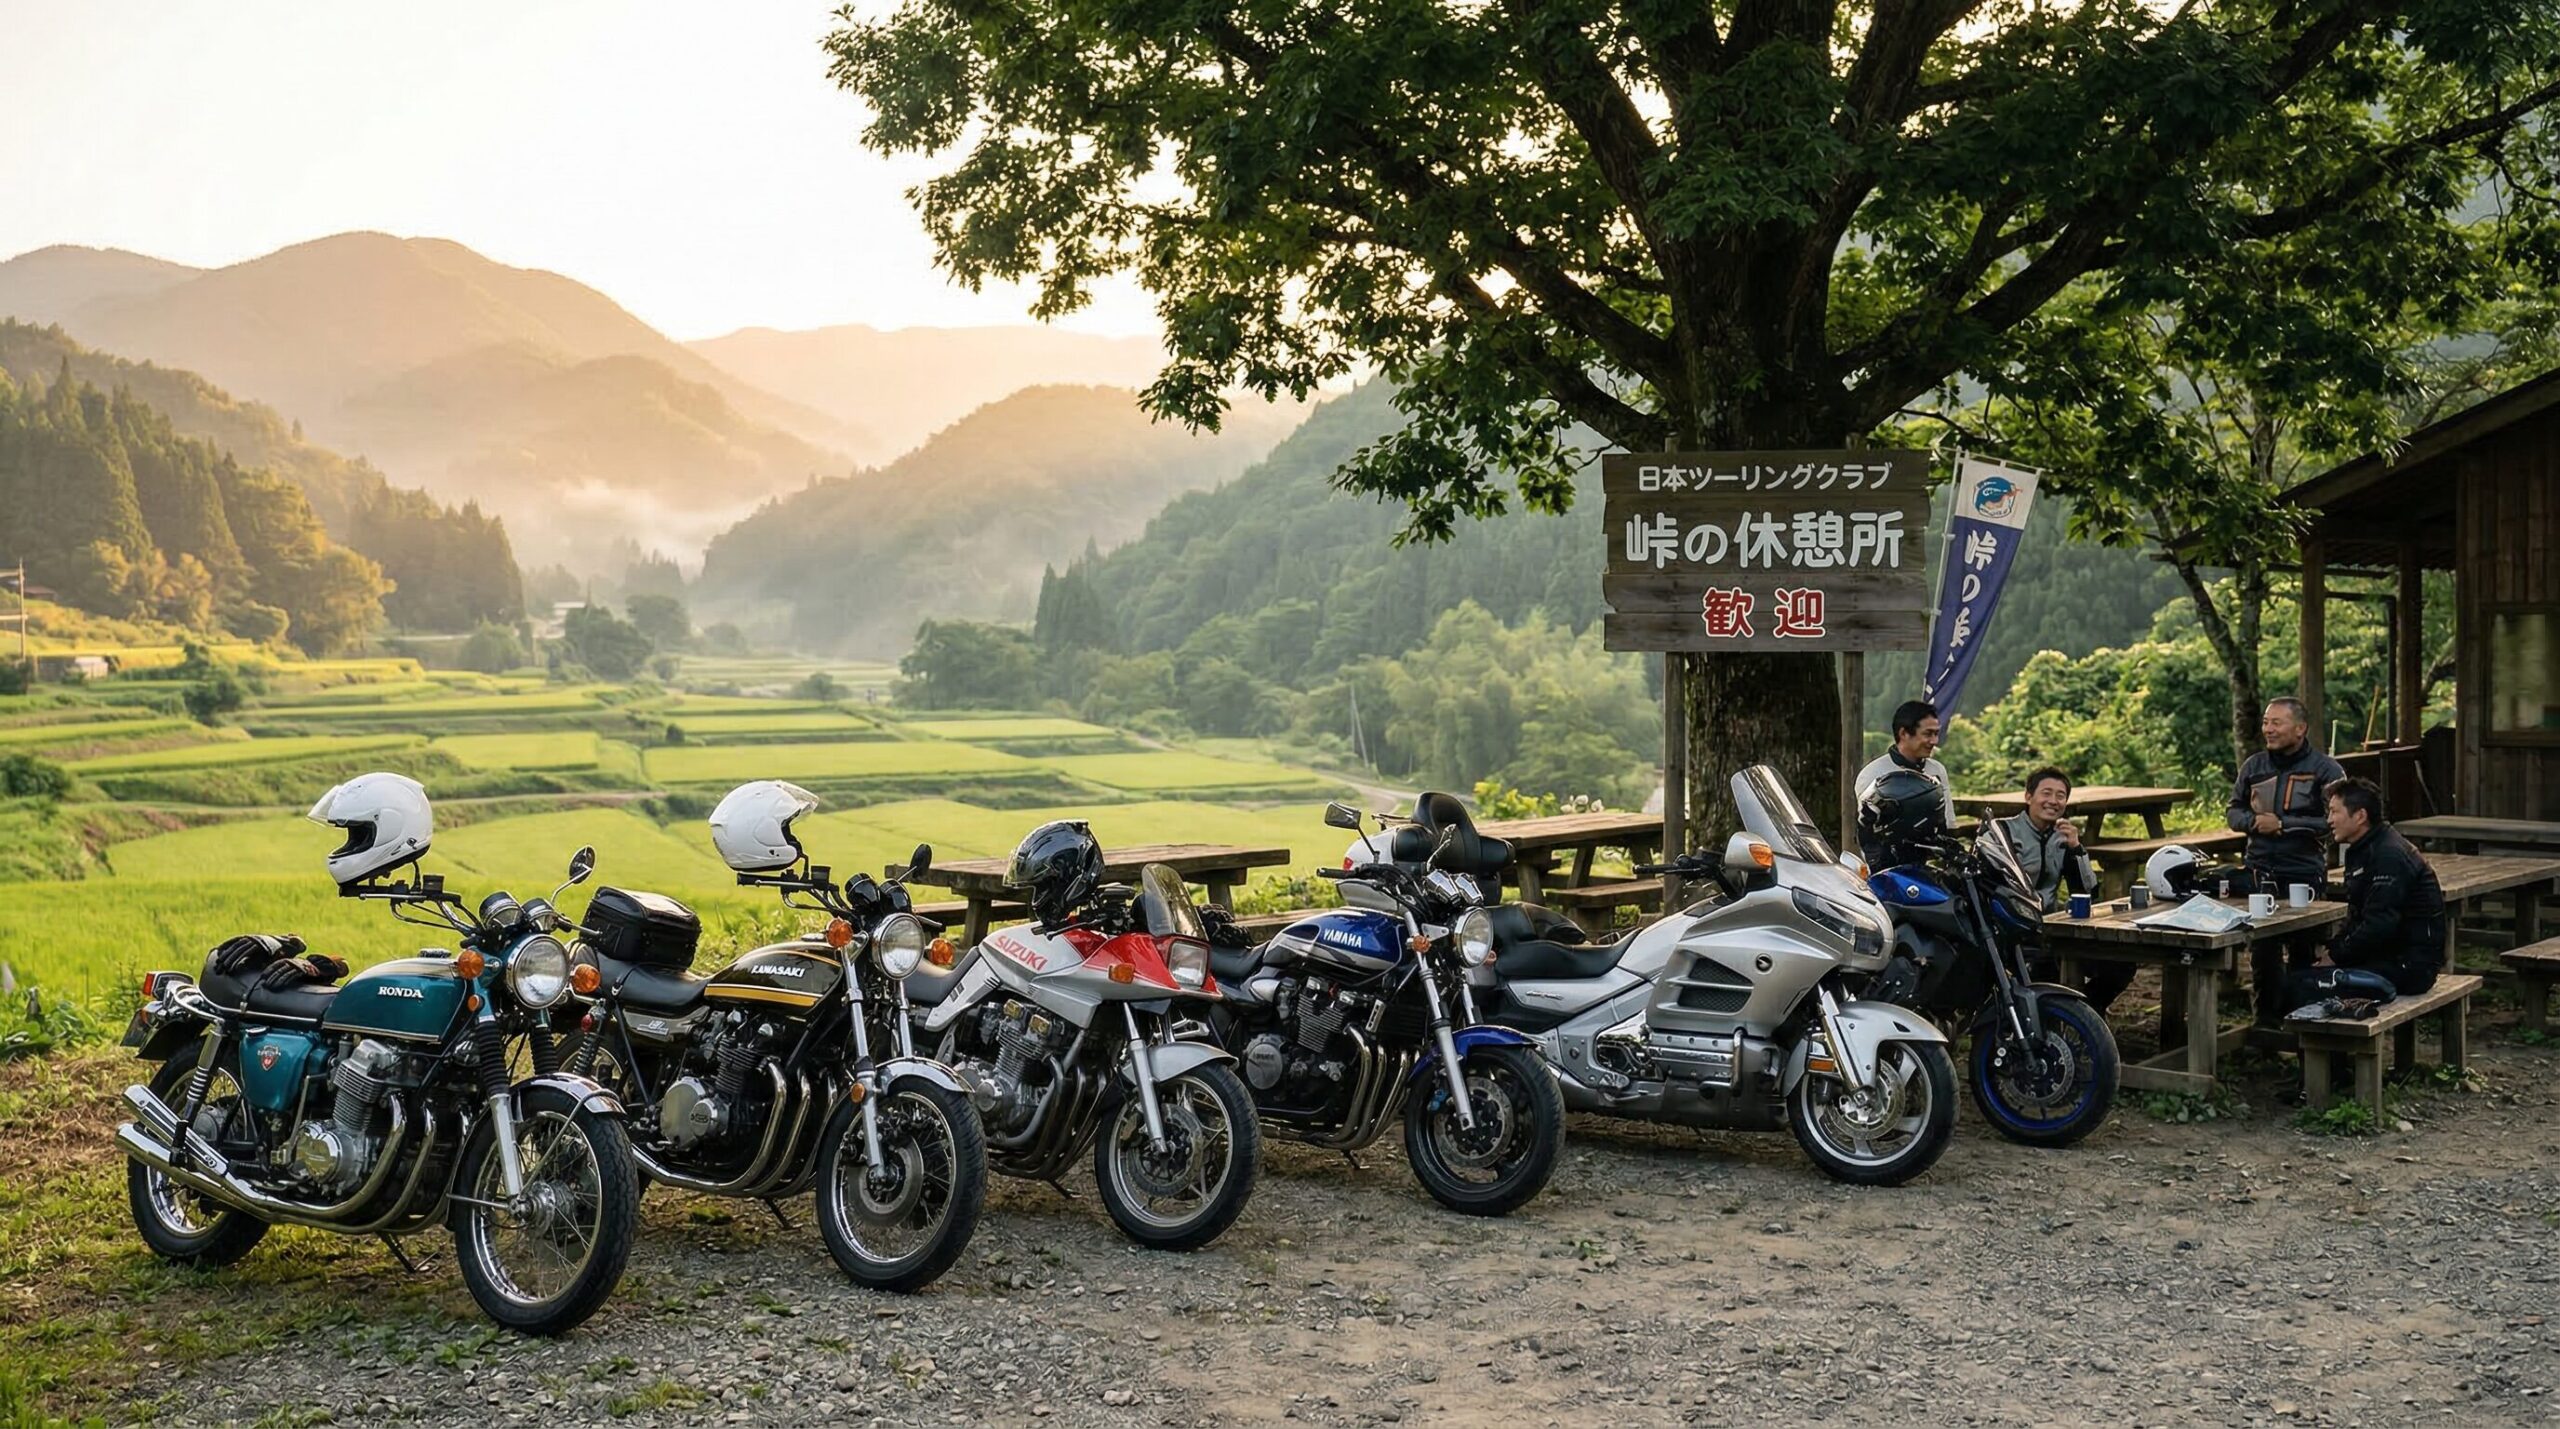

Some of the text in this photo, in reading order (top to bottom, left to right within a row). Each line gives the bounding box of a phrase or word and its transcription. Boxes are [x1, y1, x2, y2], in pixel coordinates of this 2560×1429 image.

[1639, 462, 1893, 492] 日本ツーリングクラブ
[1626, 511, 1904, 569] 峠の休憩所
[1702, 587, 1826, 638] 歓迎
[995, 935, 1048, 971] SUZUKI
[1323, 928, 1362, 948] YAMAHA
[751, 965, 806, 978] KAWASAKI
[378, 986, 424, 998] HONDA
